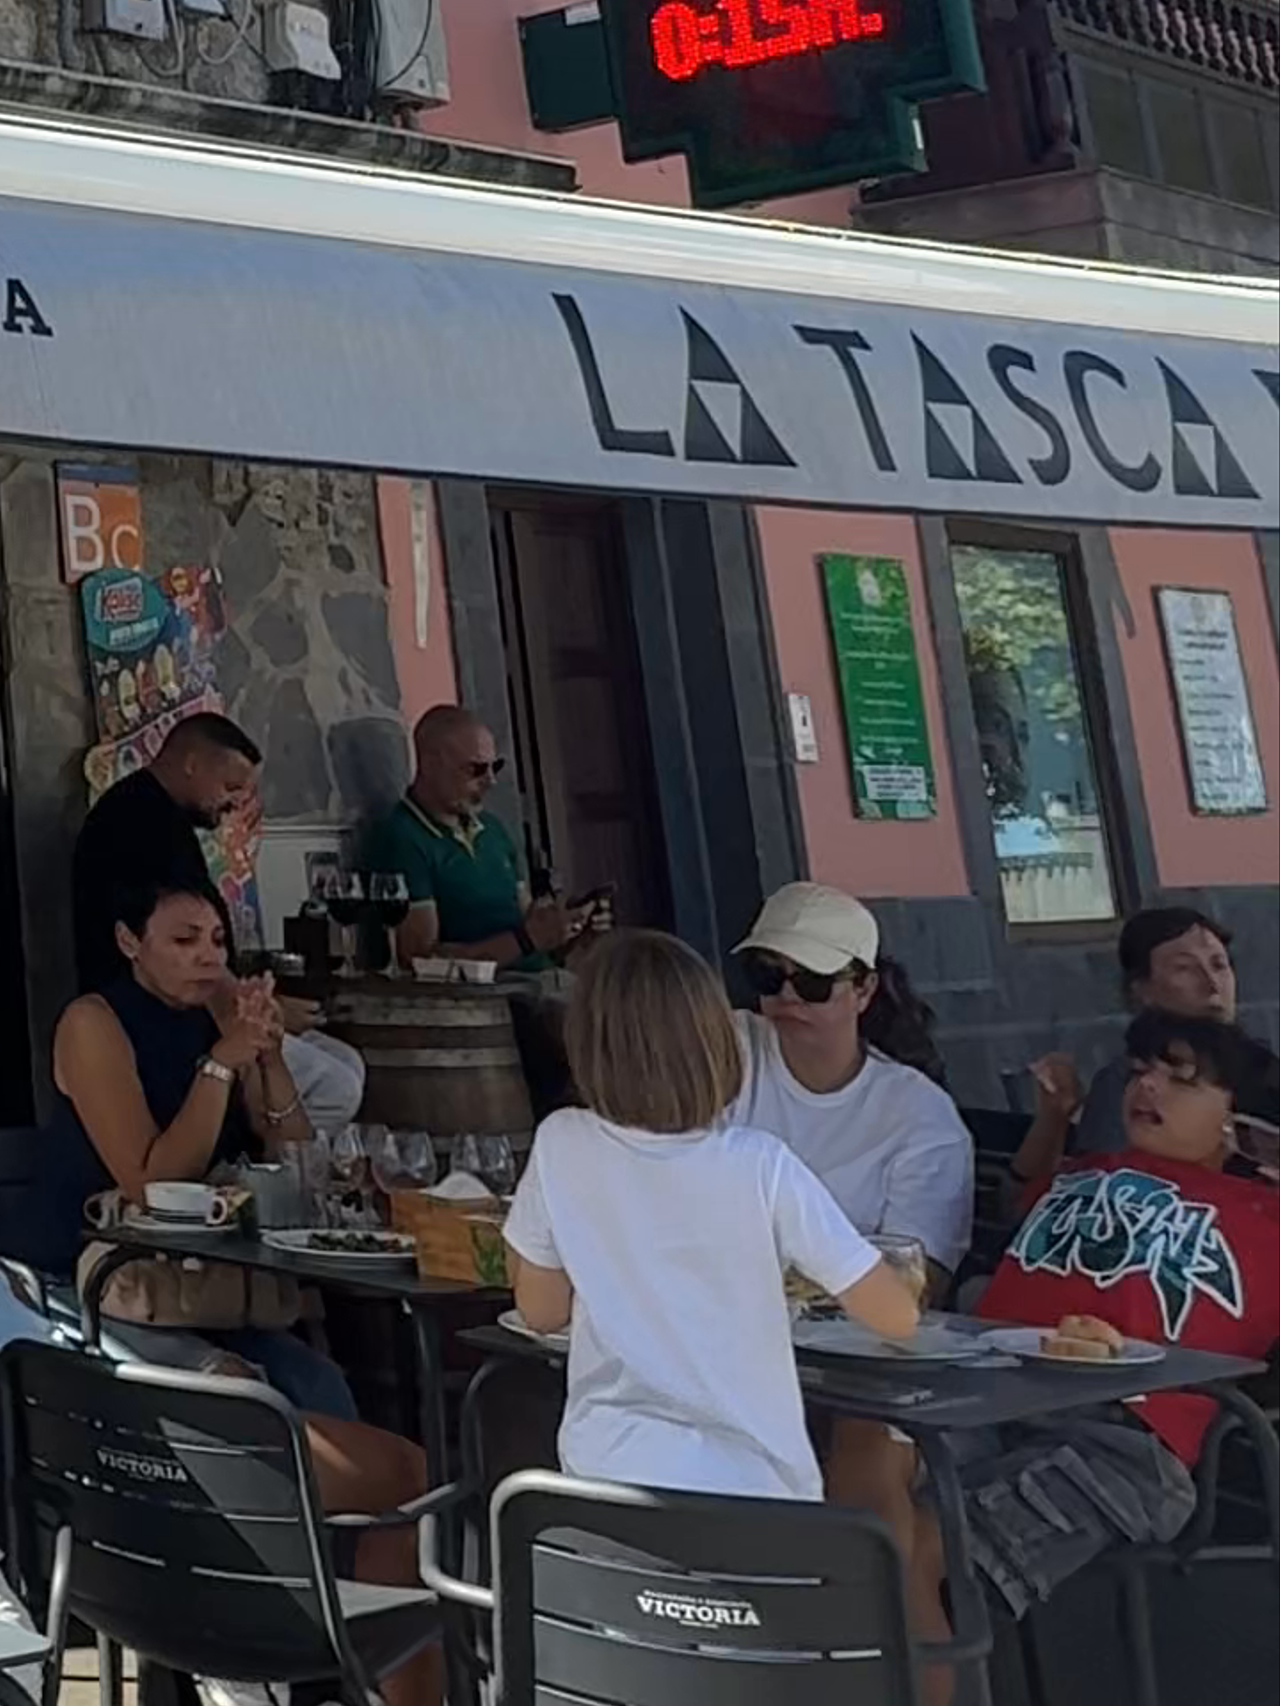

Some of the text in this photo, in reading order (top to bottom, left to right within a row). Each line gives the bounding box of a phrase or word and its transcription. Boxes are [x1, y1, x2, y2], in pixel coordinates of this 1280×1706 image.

[552, 292, 1262, 500] LA TASCA
[637, 1595, 761, 1626] VICTORIA
